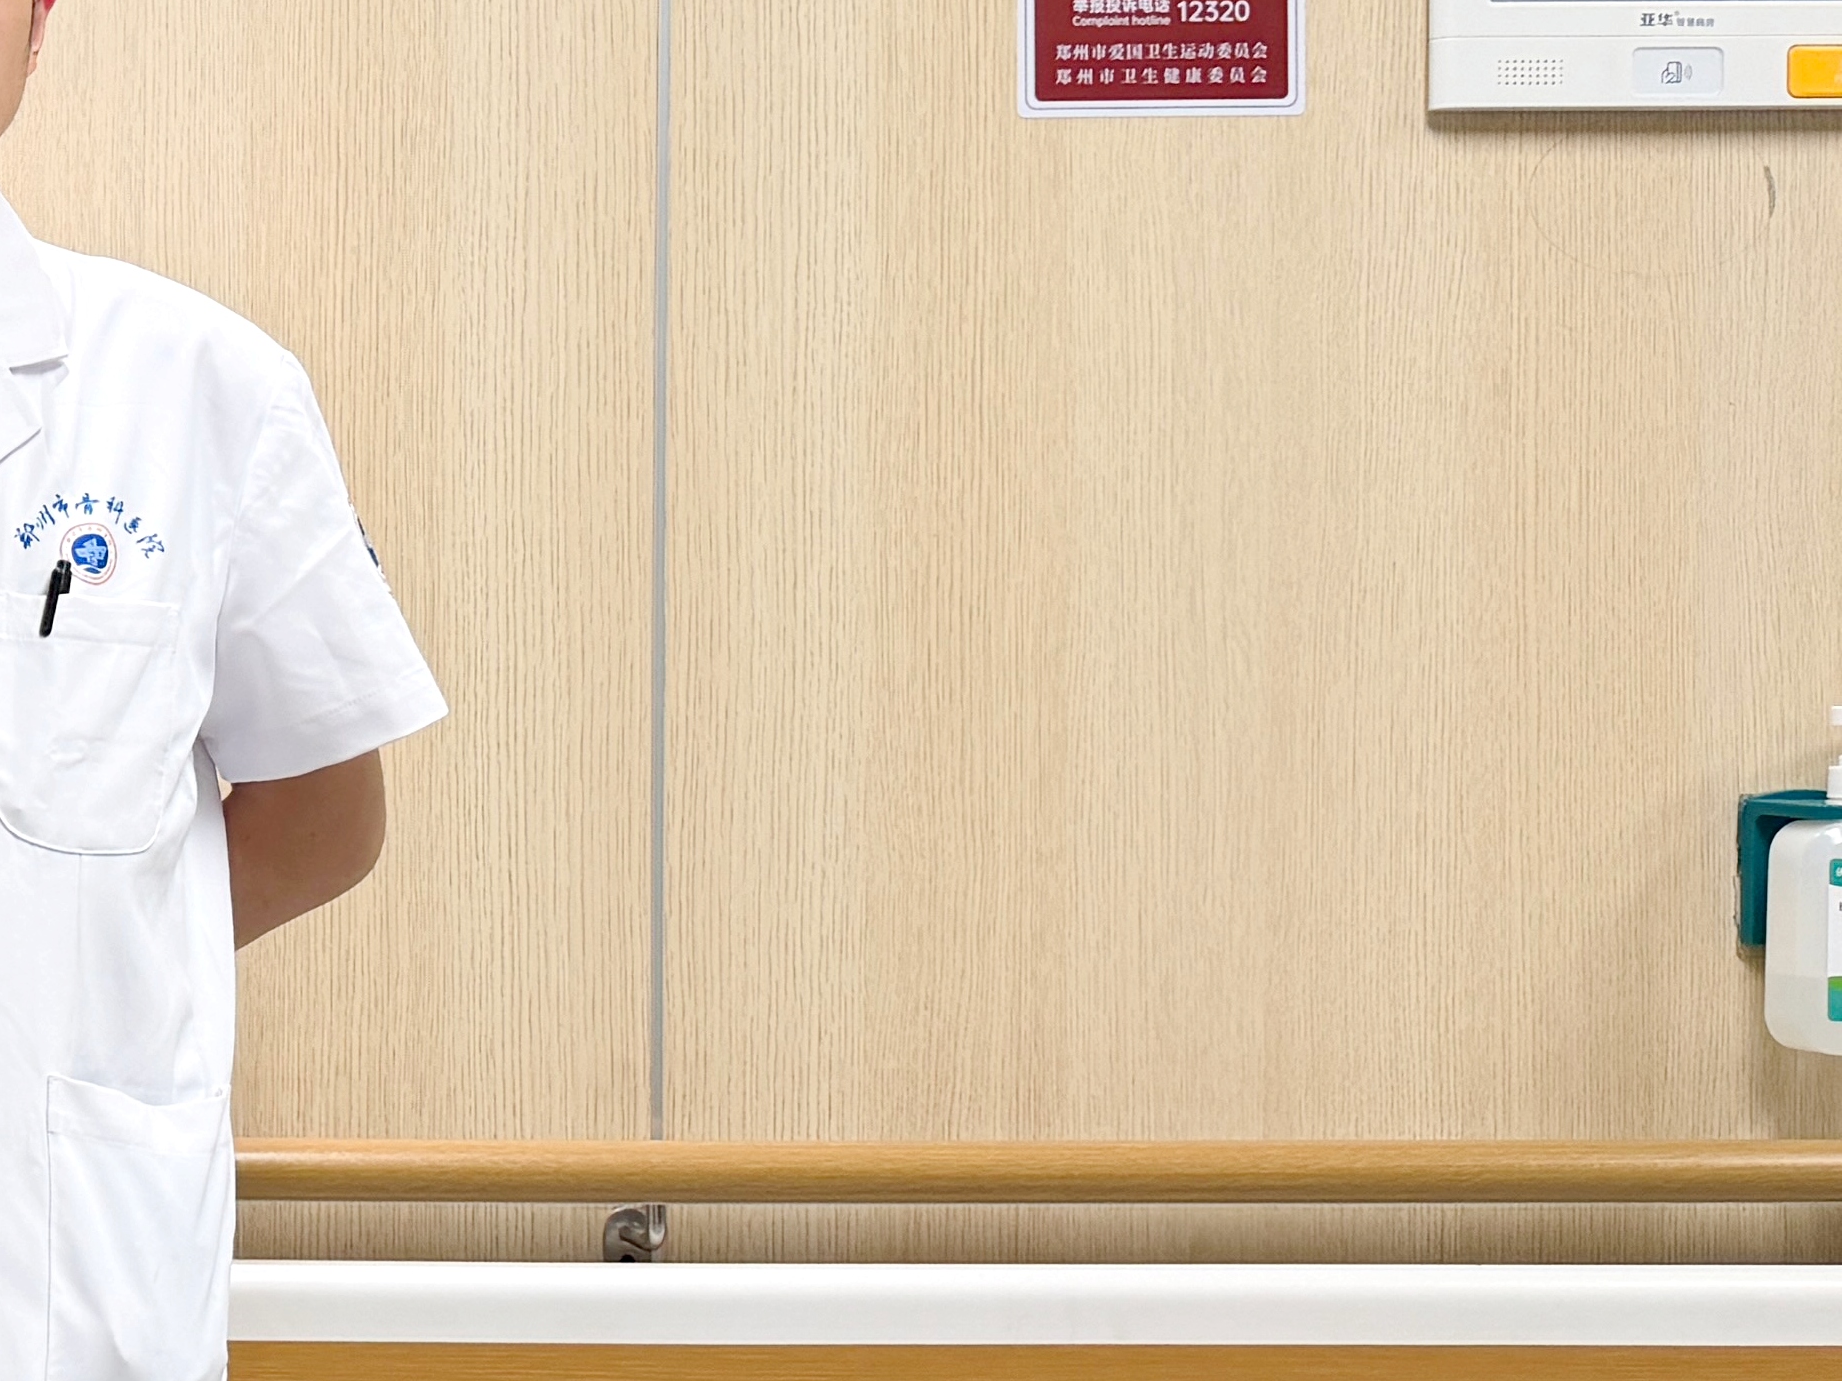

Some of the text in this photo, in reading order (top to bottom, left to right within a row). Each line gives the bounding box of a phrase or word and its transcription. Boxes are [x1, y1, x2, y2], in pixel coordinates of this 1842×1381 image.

[1177, 0, 1251, 23] 12320
[1055, 41, 1268, 61] 郑州市爱国卫生运动委员会
[1055, 66, 1267, 85] 郑州市卫生健康委员会
